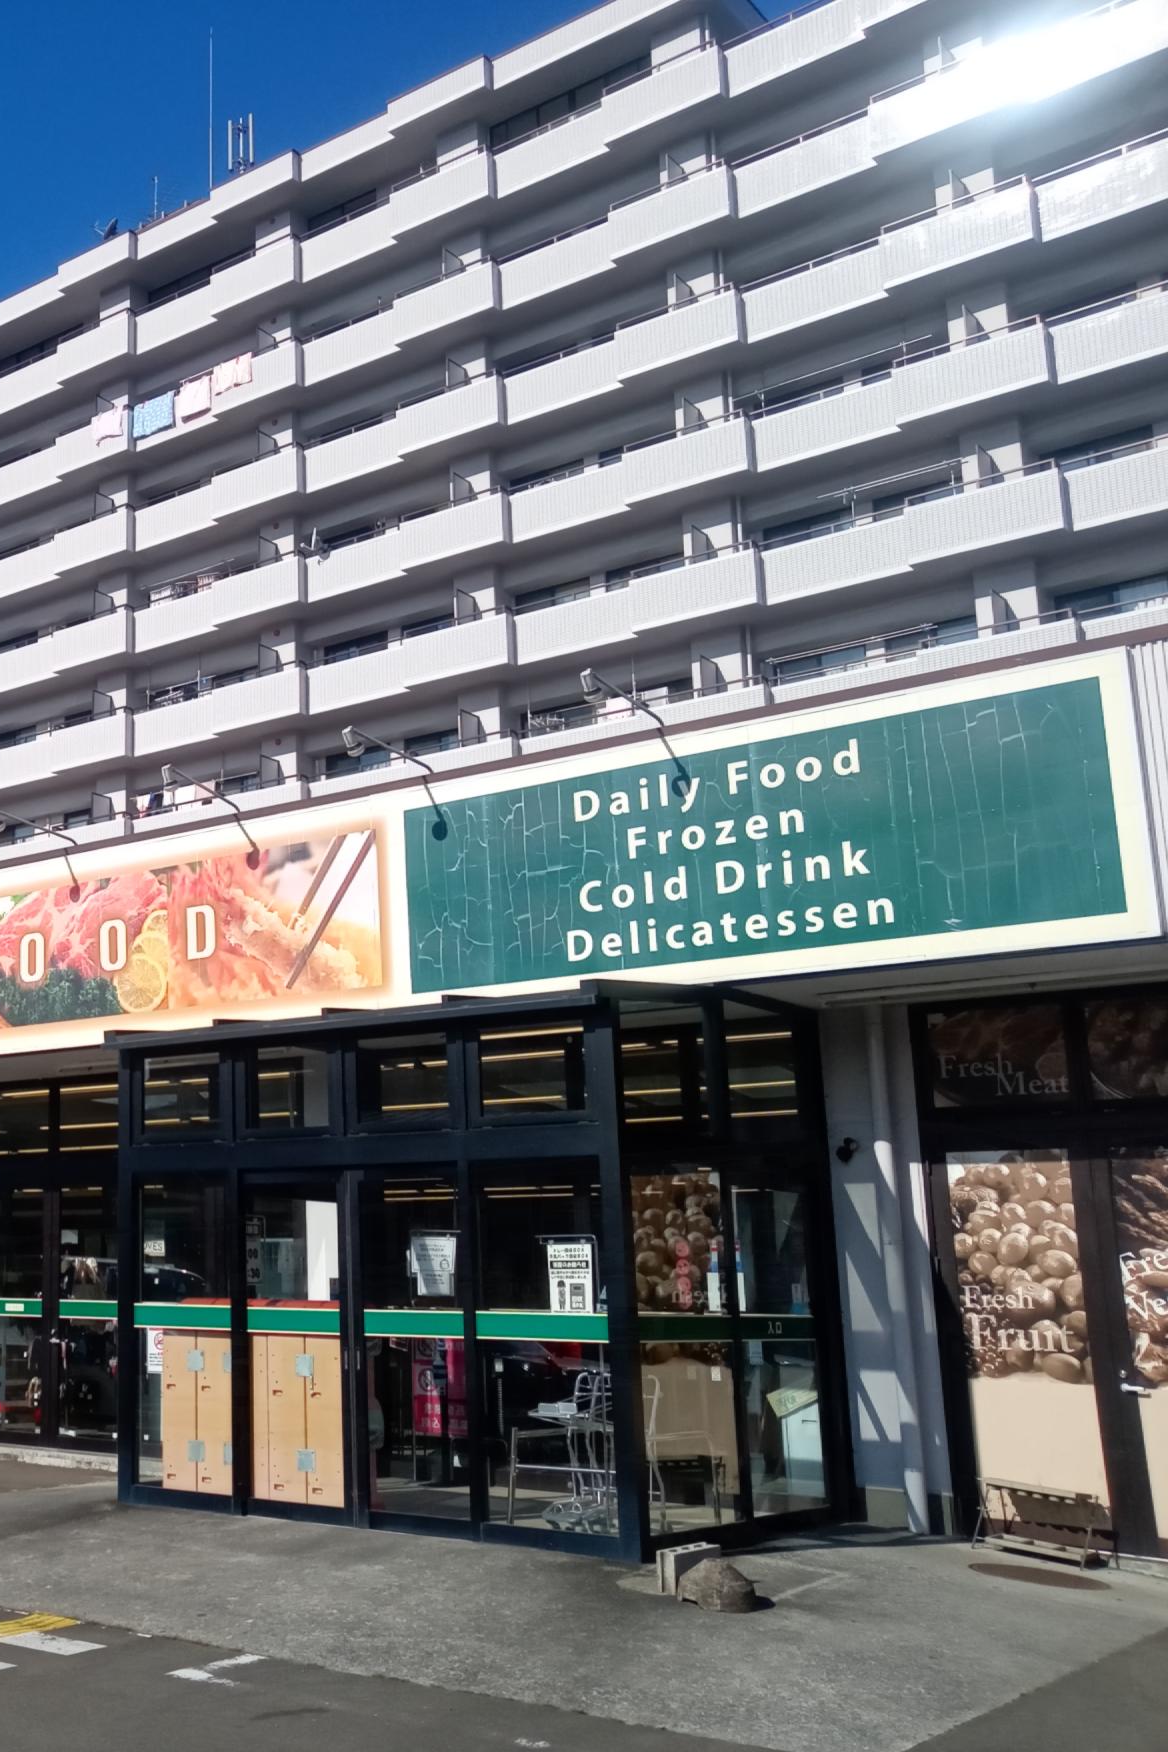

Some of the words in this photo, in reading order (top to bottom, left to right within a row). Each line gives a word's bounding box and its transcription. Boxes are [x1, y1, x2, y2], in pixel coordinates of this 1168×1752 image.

[572, 773, 700, 822] Daily
[727, 738, 861, 795] Food
[627, 807, 805, 860] Frozen
[579, 866, 688, 912] Cold
[715, 840, 871, 895] Drink
[566, 896, 895, 962] Delicatessen
[937, 1052, 1013, 1079] Fresh
[994, 1071, 1070, 1096] Meat
[1119, 1251, 1168, 1287] Fre
[962, 1285, 1036, 1309] Fresh
[966, 1312, 1076, 1353] Fruit
